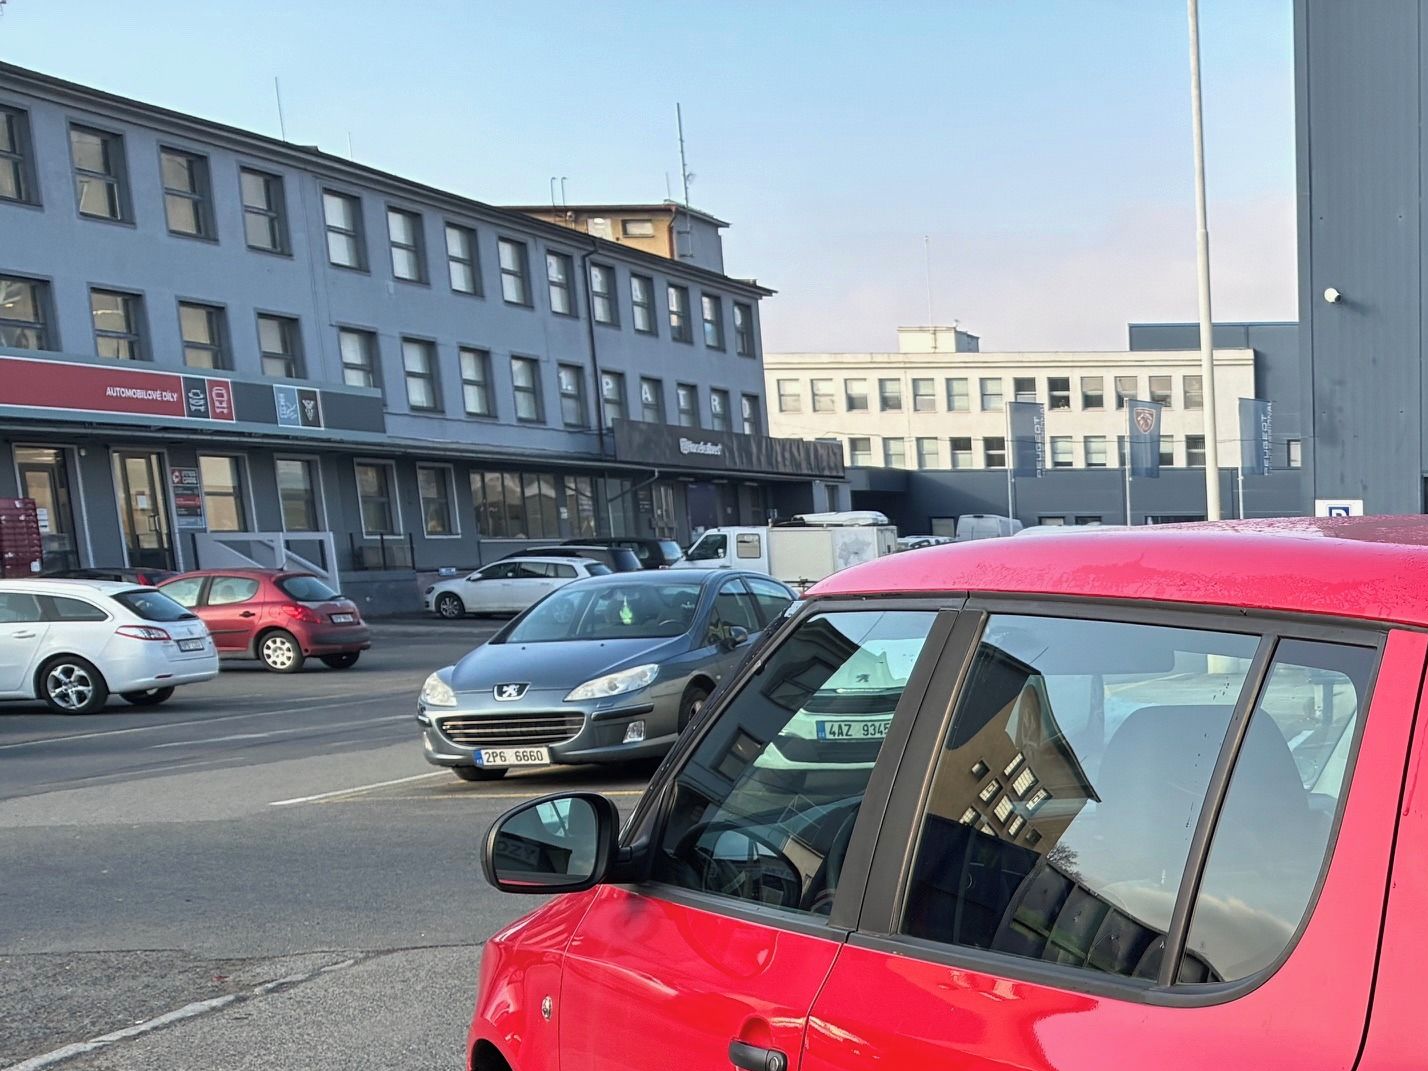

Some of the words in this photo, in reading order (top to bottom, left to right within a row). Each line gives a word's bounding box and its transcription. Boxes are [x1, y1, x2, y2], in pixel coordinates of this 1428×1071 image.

[106, 386, 162, 401] AUTOMOBILOVÉ
[162, 389, 178, 402] DÍLY
[1033, 415, 1043, 478] PEUGEOT
[829, 723, 853, 737] 4AZ
[862, 722, 890, 737] 9345
[484, 750, 507, 763] 2P6
[514, 750, 544, 762] 6660
